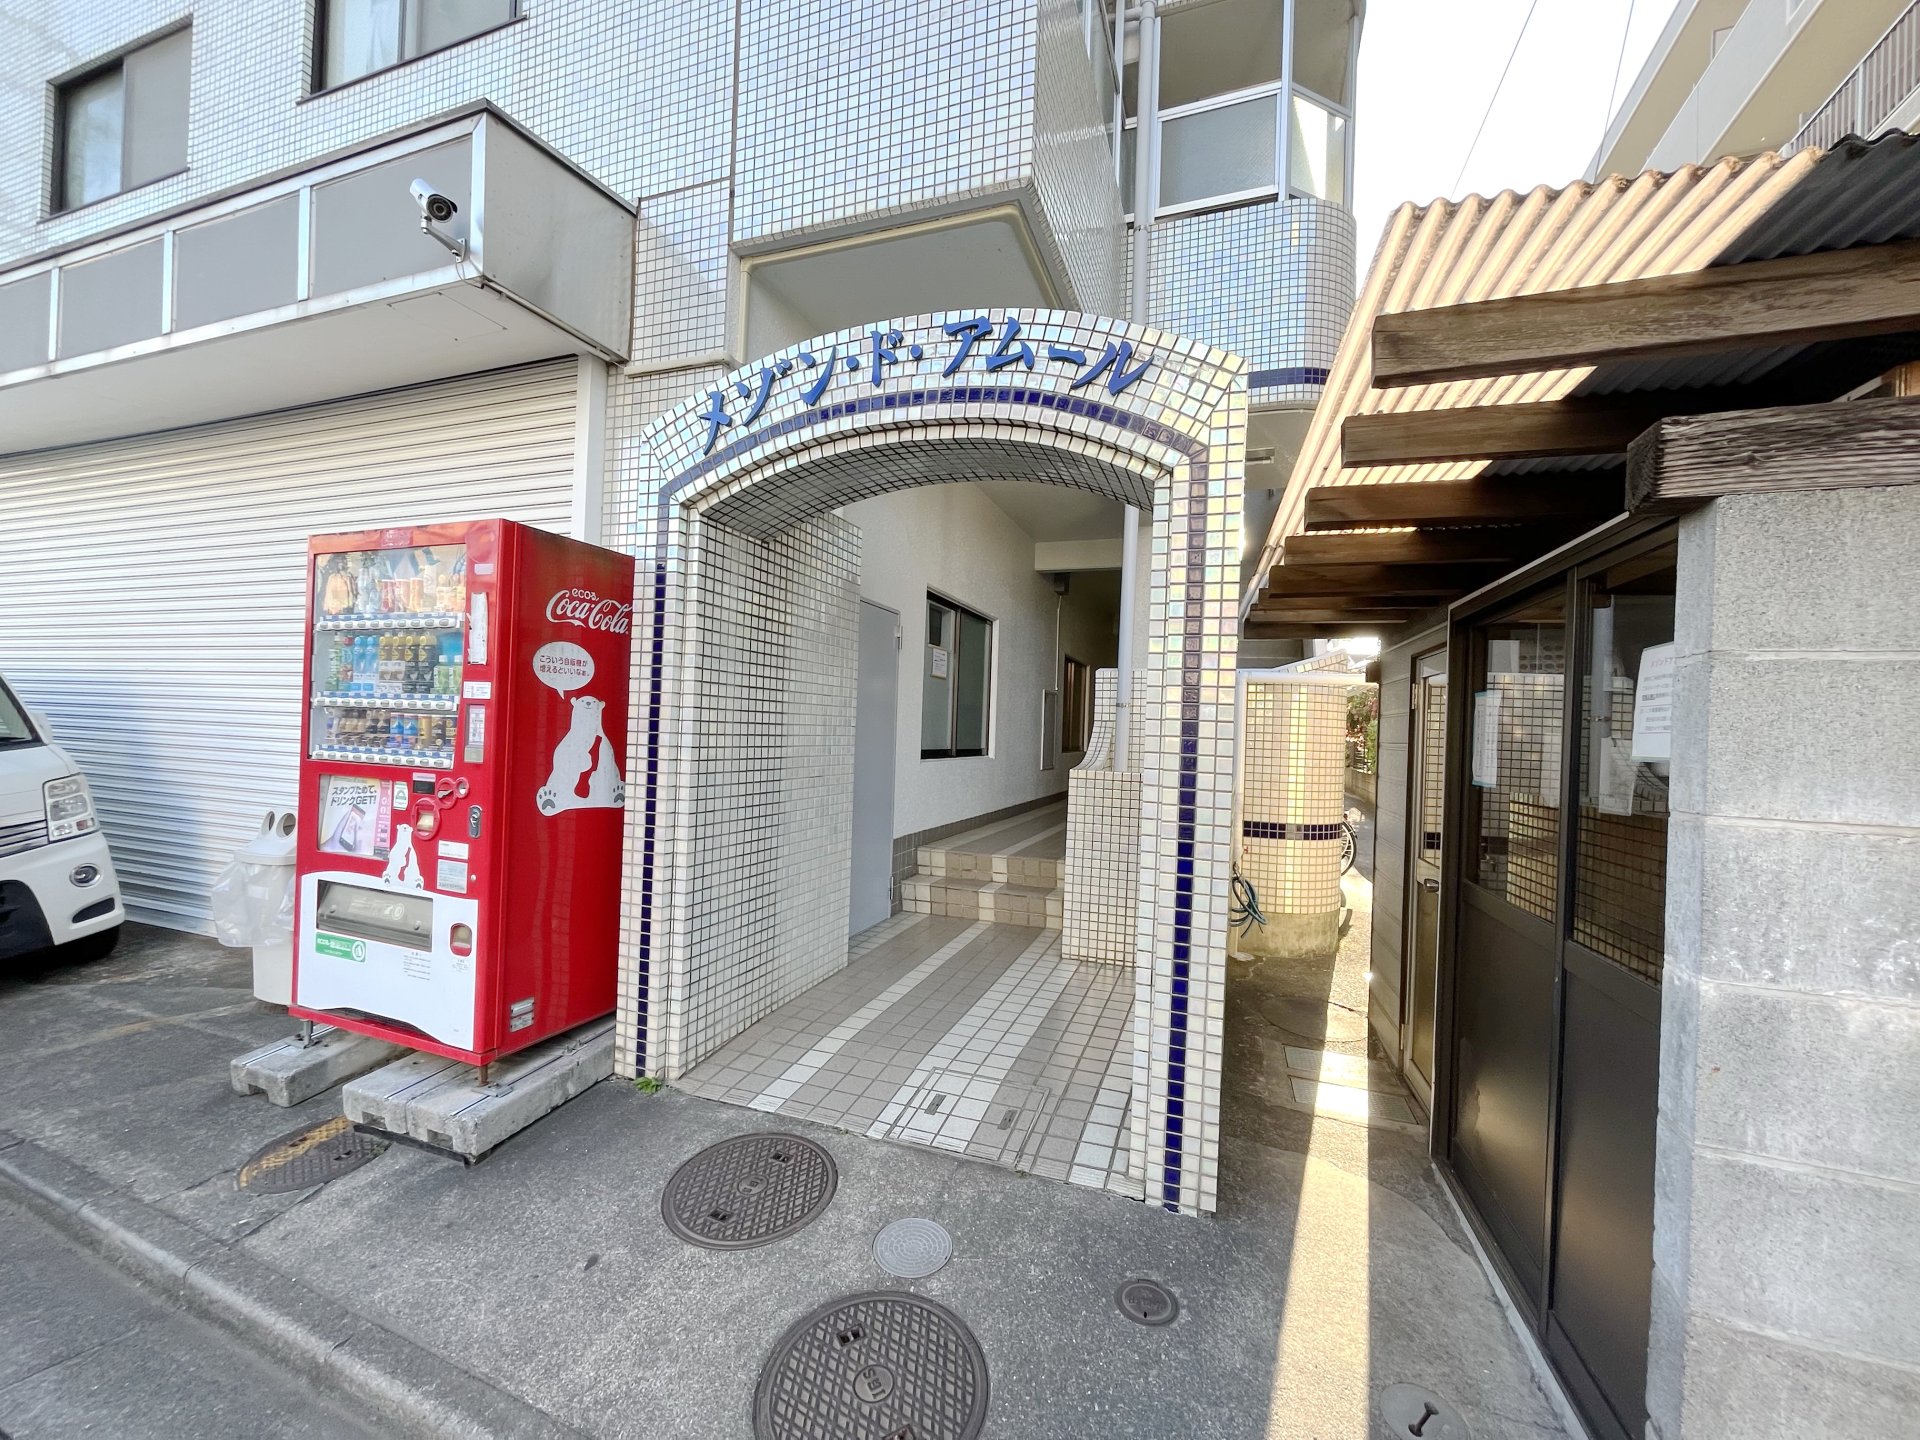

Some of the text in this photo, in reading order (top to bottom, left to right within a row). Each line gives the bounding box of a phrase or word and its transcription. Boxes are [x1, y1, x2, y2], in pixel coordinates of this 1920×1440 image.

[698, 316, 1154, 455] メゾン・ド・アムール
[545, 589, 632, 634] Coca-Cola
[540, 654, 588, 667] こういう自販機が
